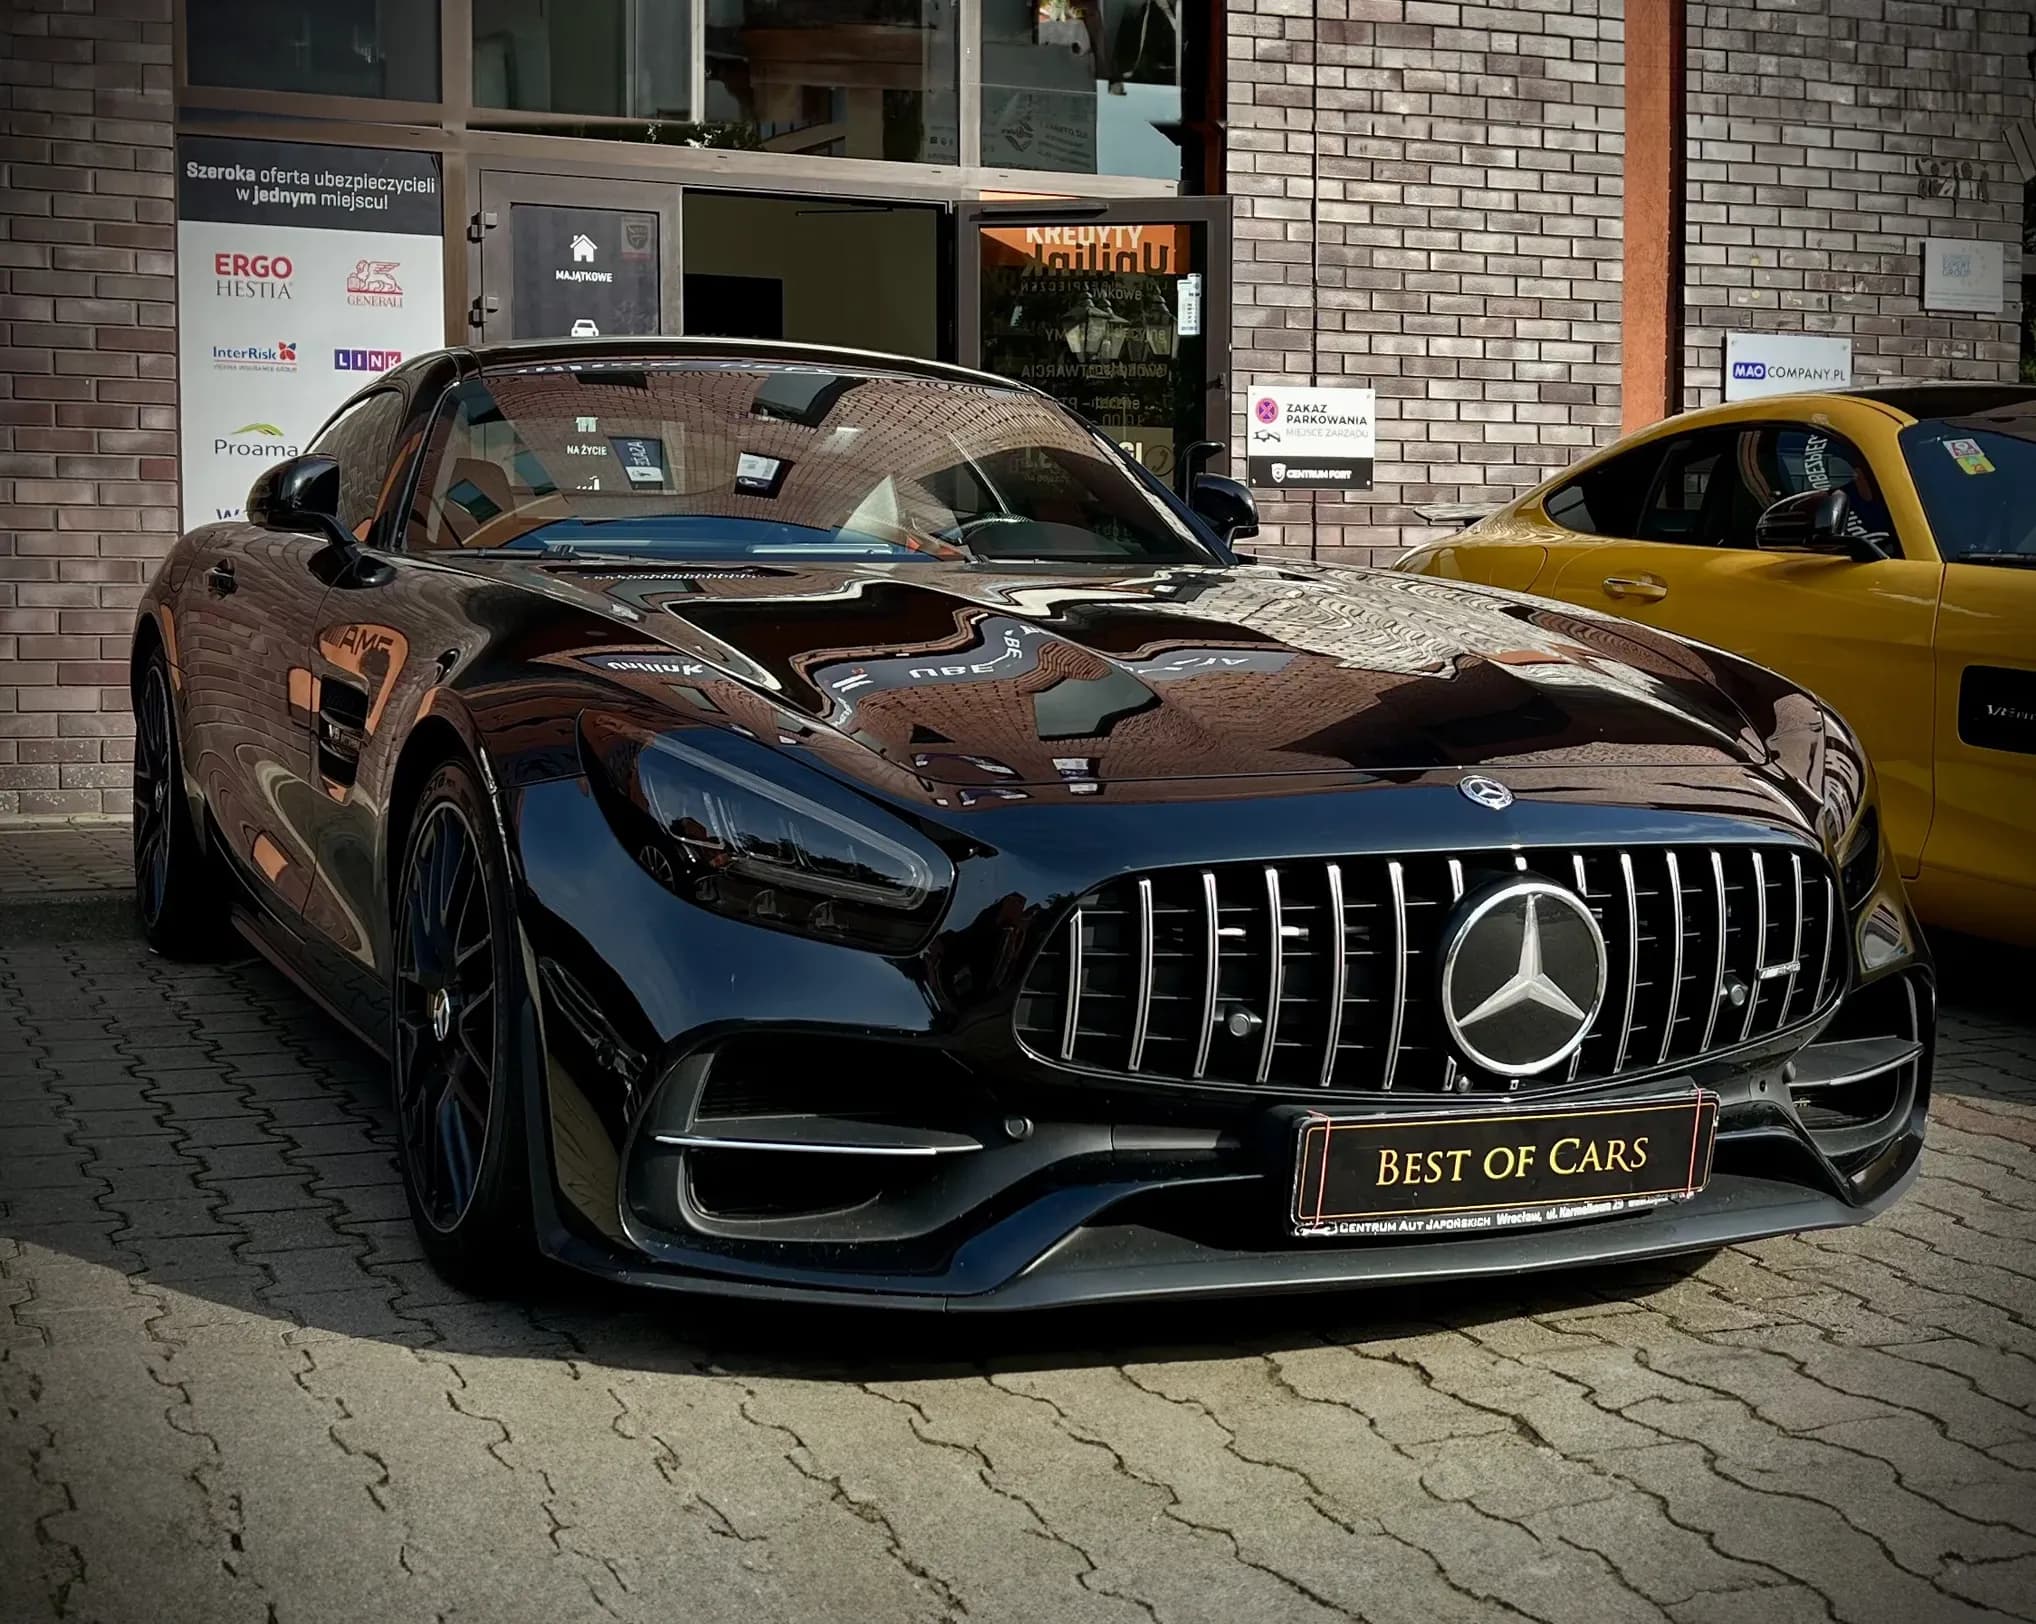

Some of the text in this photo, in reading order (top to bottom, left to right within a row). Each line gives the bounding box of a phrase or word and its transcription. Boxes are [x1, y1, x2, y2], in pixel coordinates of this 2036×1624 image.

[186, 161, 435, 195] Szeroka oferta ubezpieczycieli
[236, 185, 388, 211] w jednym miejscu!
[215, 253, 293, 279] ERGO
[555, 270, 613, 283] MAJĄTKOWE
[216, 280, 292, 300] HESTIA
[347, 295, 403, 309] GENERALI
[213, 346, 277, 361] InterRisk
[336, 350, 401, 370] LINK
[1767, 366, 1846, 381] COMPANY.PL
[1286, 403, 1328, 413] ZAKAZ
[1286, 415, 1367, 425] PARKOWANIA
[214, 439, 299, 457] Proama
[567, 443, 608, 456] NA ŻYCIE
[1286, 469, 1328, 479] CENTRUM
[1376, 1137, 1649, 1186] BEST OF CARS
[1339, 1221, 1397, 1233] CENTRUM
[1399, 1220, 1425, 1231] AUT
